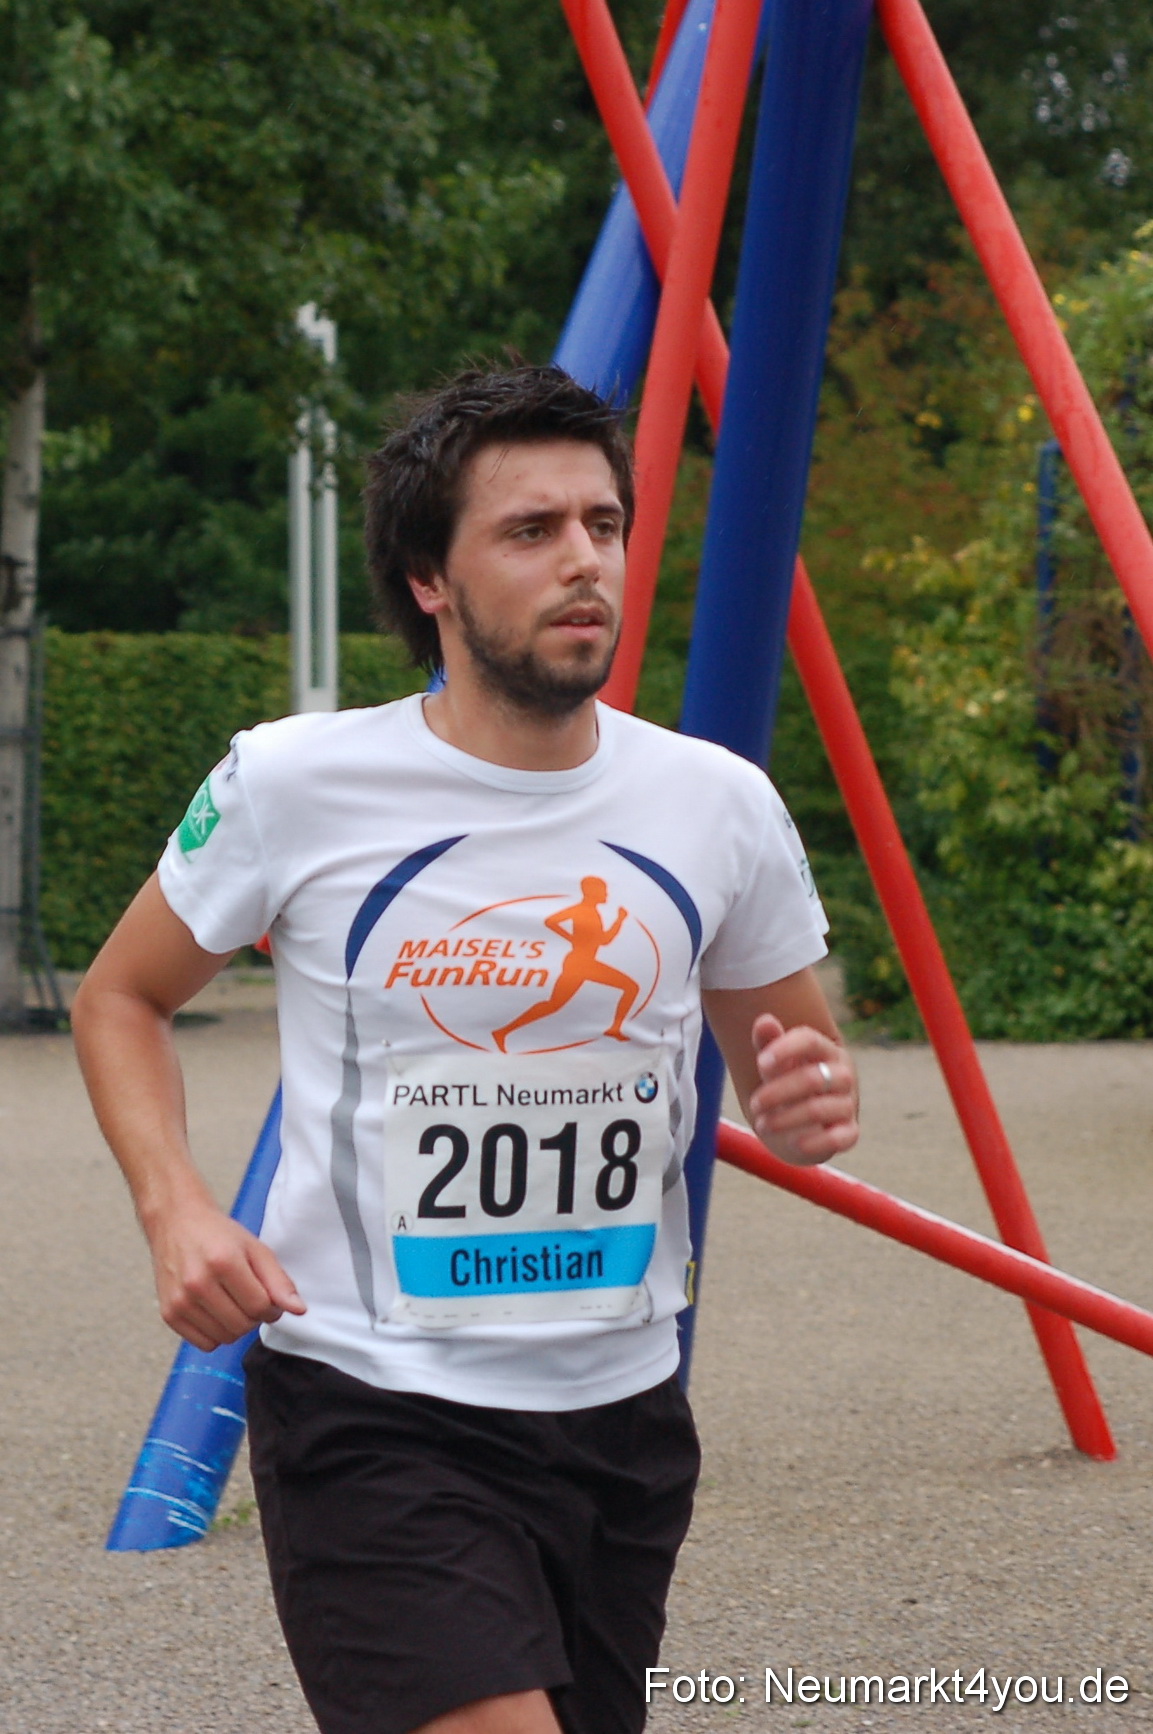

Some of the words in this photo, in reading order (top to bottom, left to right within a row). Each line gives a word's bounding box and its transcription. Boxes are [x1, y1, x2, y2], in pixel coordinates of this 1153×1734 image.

[397, 938, 546, 960] MAISEL'S
[384, 960, 549, 989] FunRun
[393, 1084, 488, 1106] PARTL
[496, 1081, 624, 1106] Neumarkt
[417, 1118, 642, 1219] 2018
[397, 1215, 407, 1231] A
[450, 1244, 604, 1287] Christian
